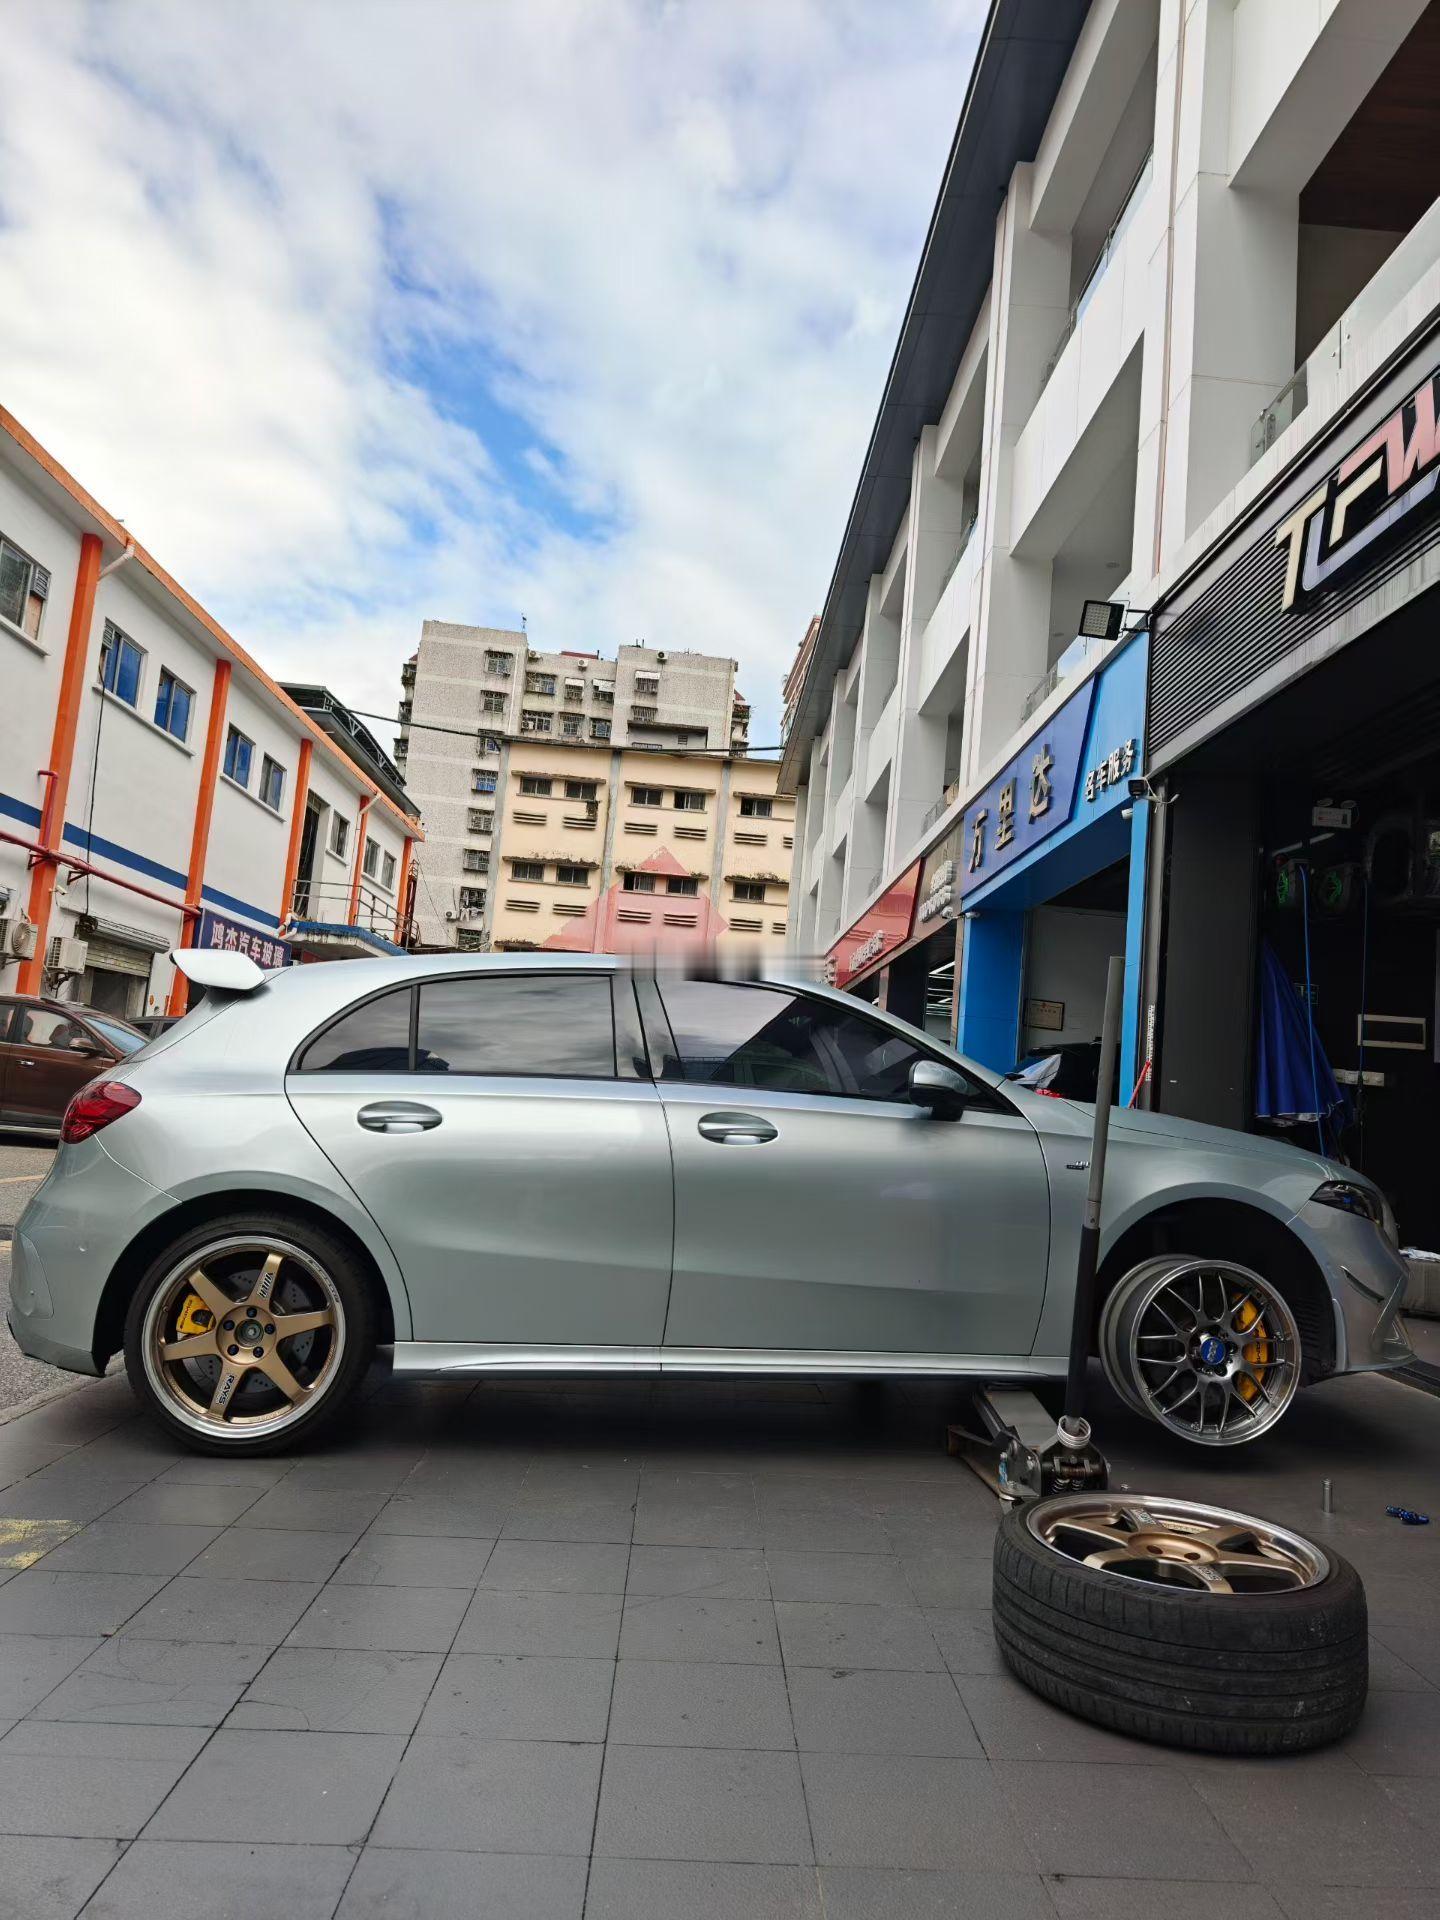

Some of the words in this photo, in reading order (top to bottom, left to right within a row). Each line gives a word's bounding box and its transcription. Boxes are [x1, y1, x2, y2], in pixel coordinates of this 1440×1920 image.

[1085, 738, 1137, 802] 名车服务
[968, 743, 1055, 873] 万里达
[216, 1374, 235, 1405] RAYS
